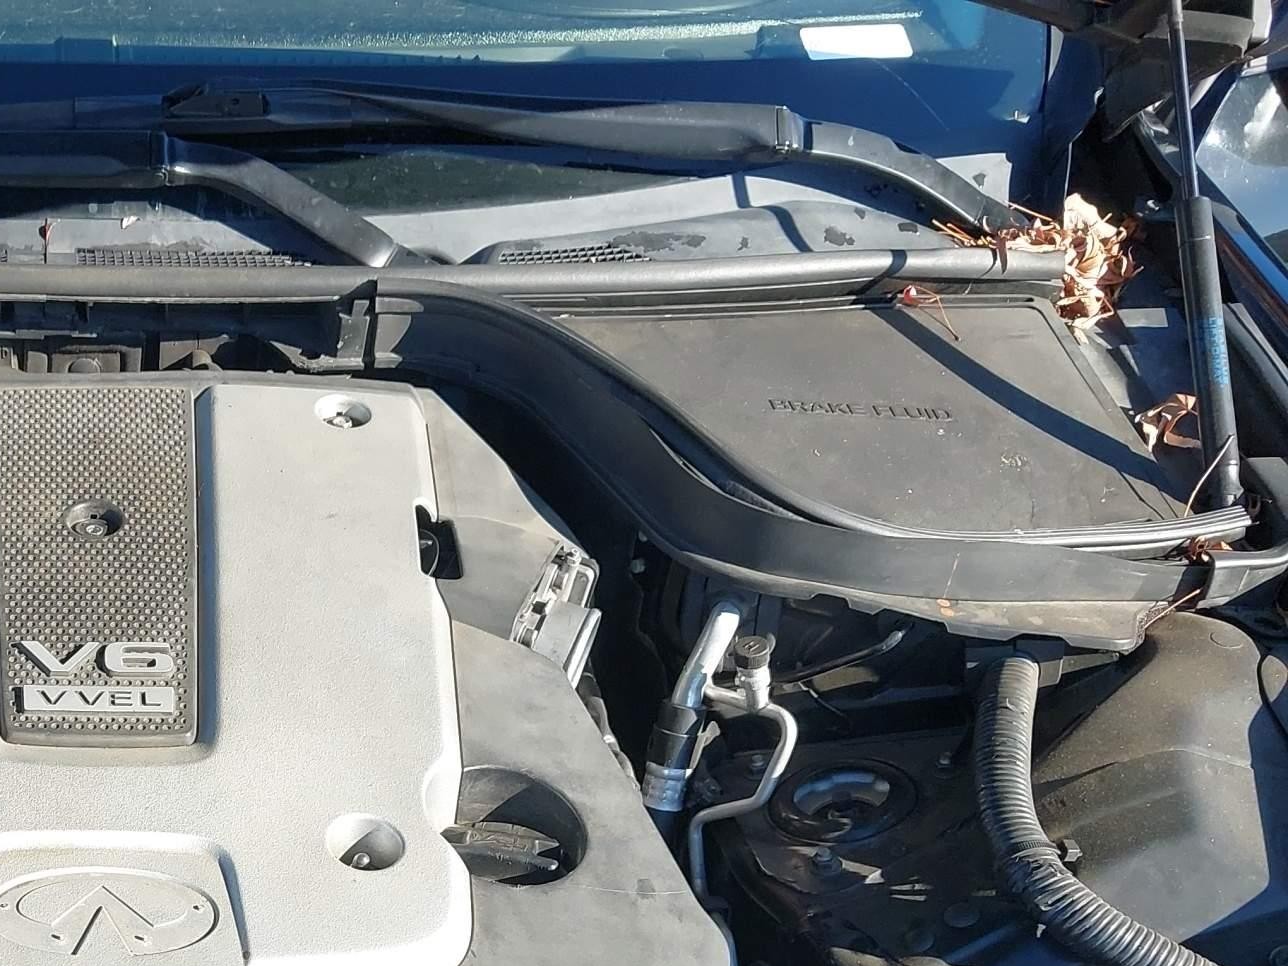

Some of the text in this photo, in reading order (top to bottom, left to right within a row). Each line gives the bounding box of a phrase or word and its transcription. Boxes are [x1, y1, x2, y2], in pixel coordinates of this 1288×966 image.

[768, 399, 953, 422] BRAKE FLUID
[20, 640, 174, 678] V6
[37, 690, 163, 707] VVEL
